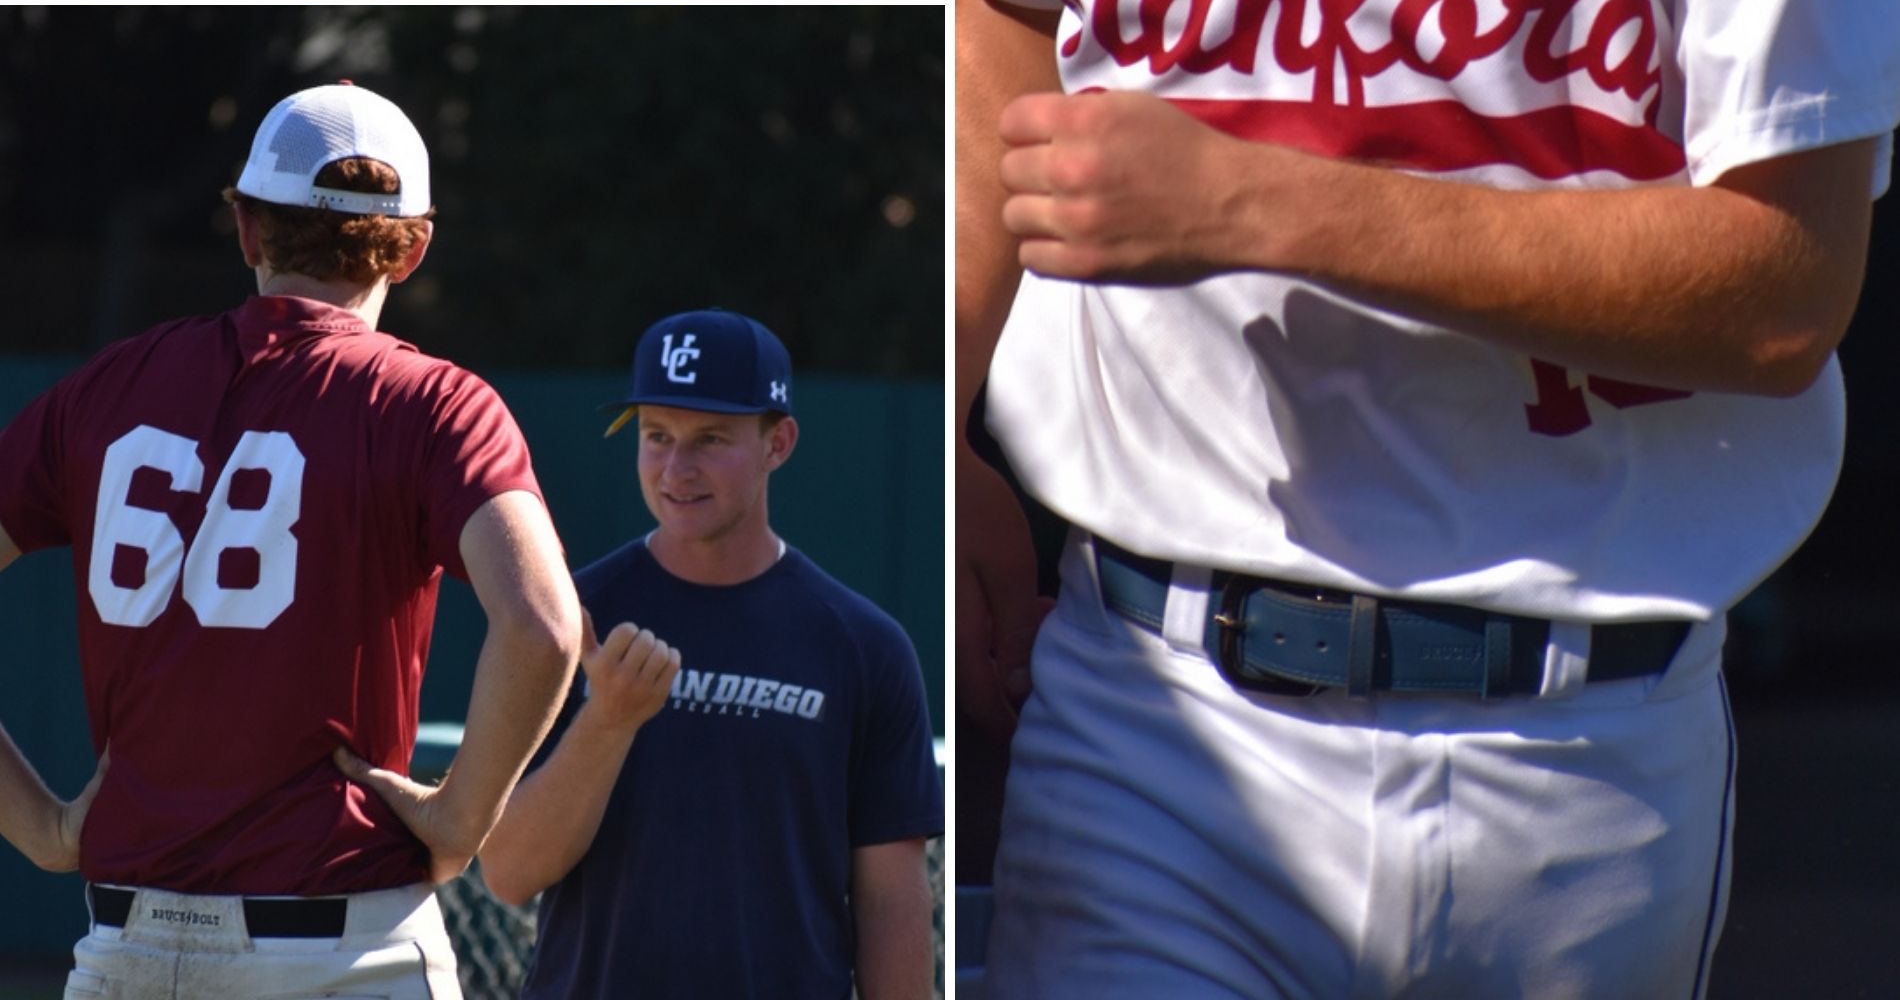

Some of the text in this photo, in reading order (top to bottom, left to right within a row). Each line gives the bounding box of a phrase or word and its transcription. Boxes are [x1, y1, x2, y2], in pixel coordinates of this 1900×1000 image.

[661, 333, 701, 384] UC
[88, 424, 306, 630] 68
[671, 669, 825, 719] AN DIEGO
